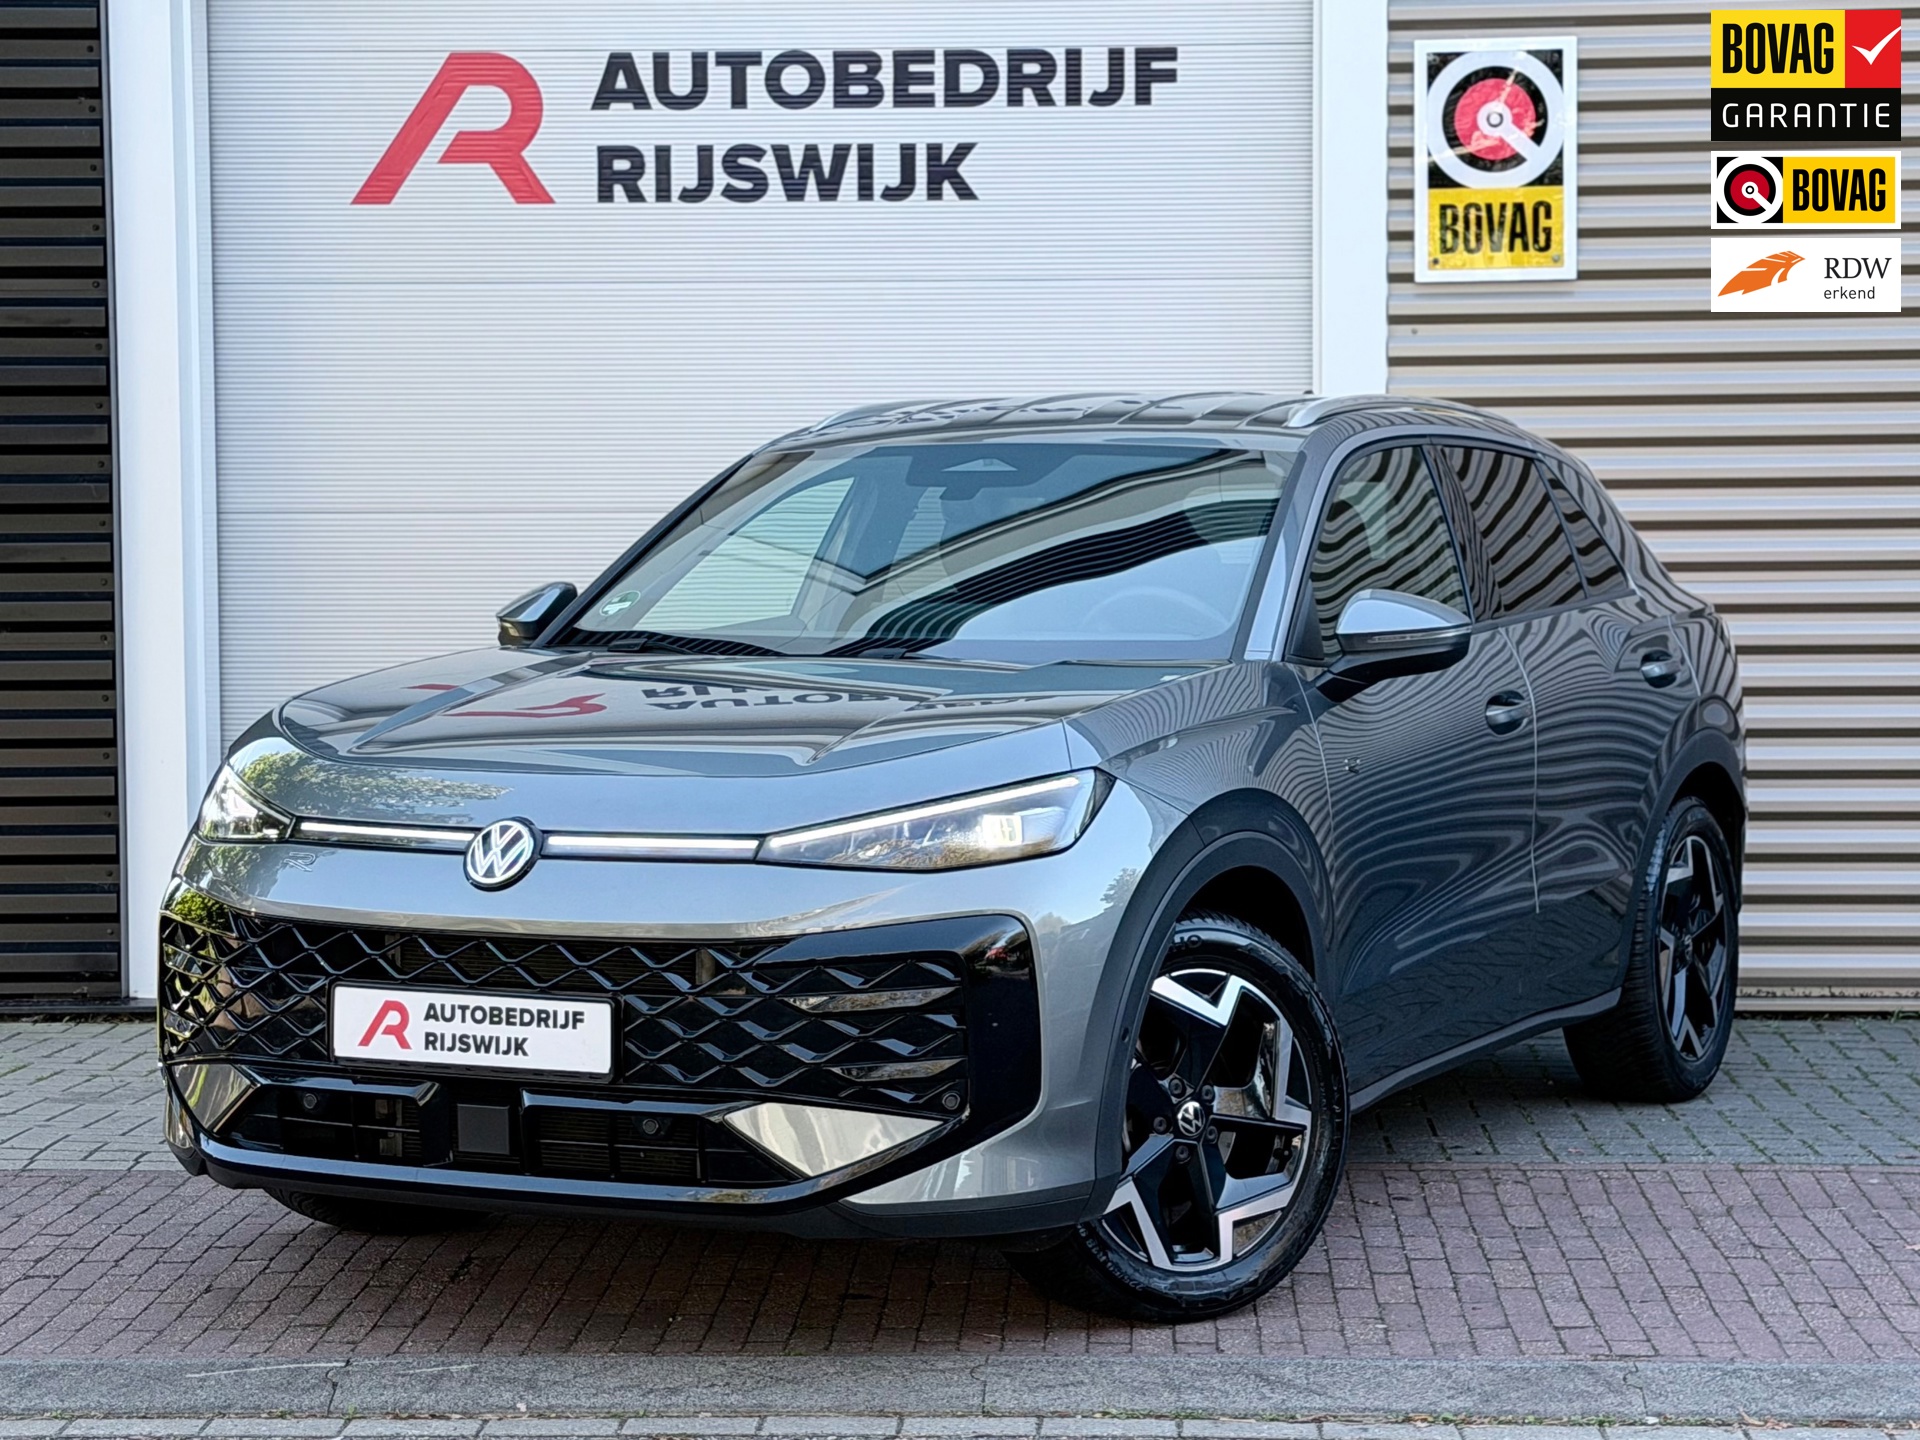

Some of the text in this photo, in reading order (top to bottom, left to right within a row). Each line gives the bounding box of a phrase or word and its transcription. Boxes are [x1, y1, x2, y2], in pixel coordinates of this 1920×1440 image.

[591, 47, 1178, 110] AUTOBEDRIJF
[597, 142, 979, 204] RIJSWIJK
[1438, 200, 1553, 255] BOVAG
[423, 1002, 586, 1030] AUTOBEDRIJF
[423, 1031, 529, 1057] RIJSWIJK
